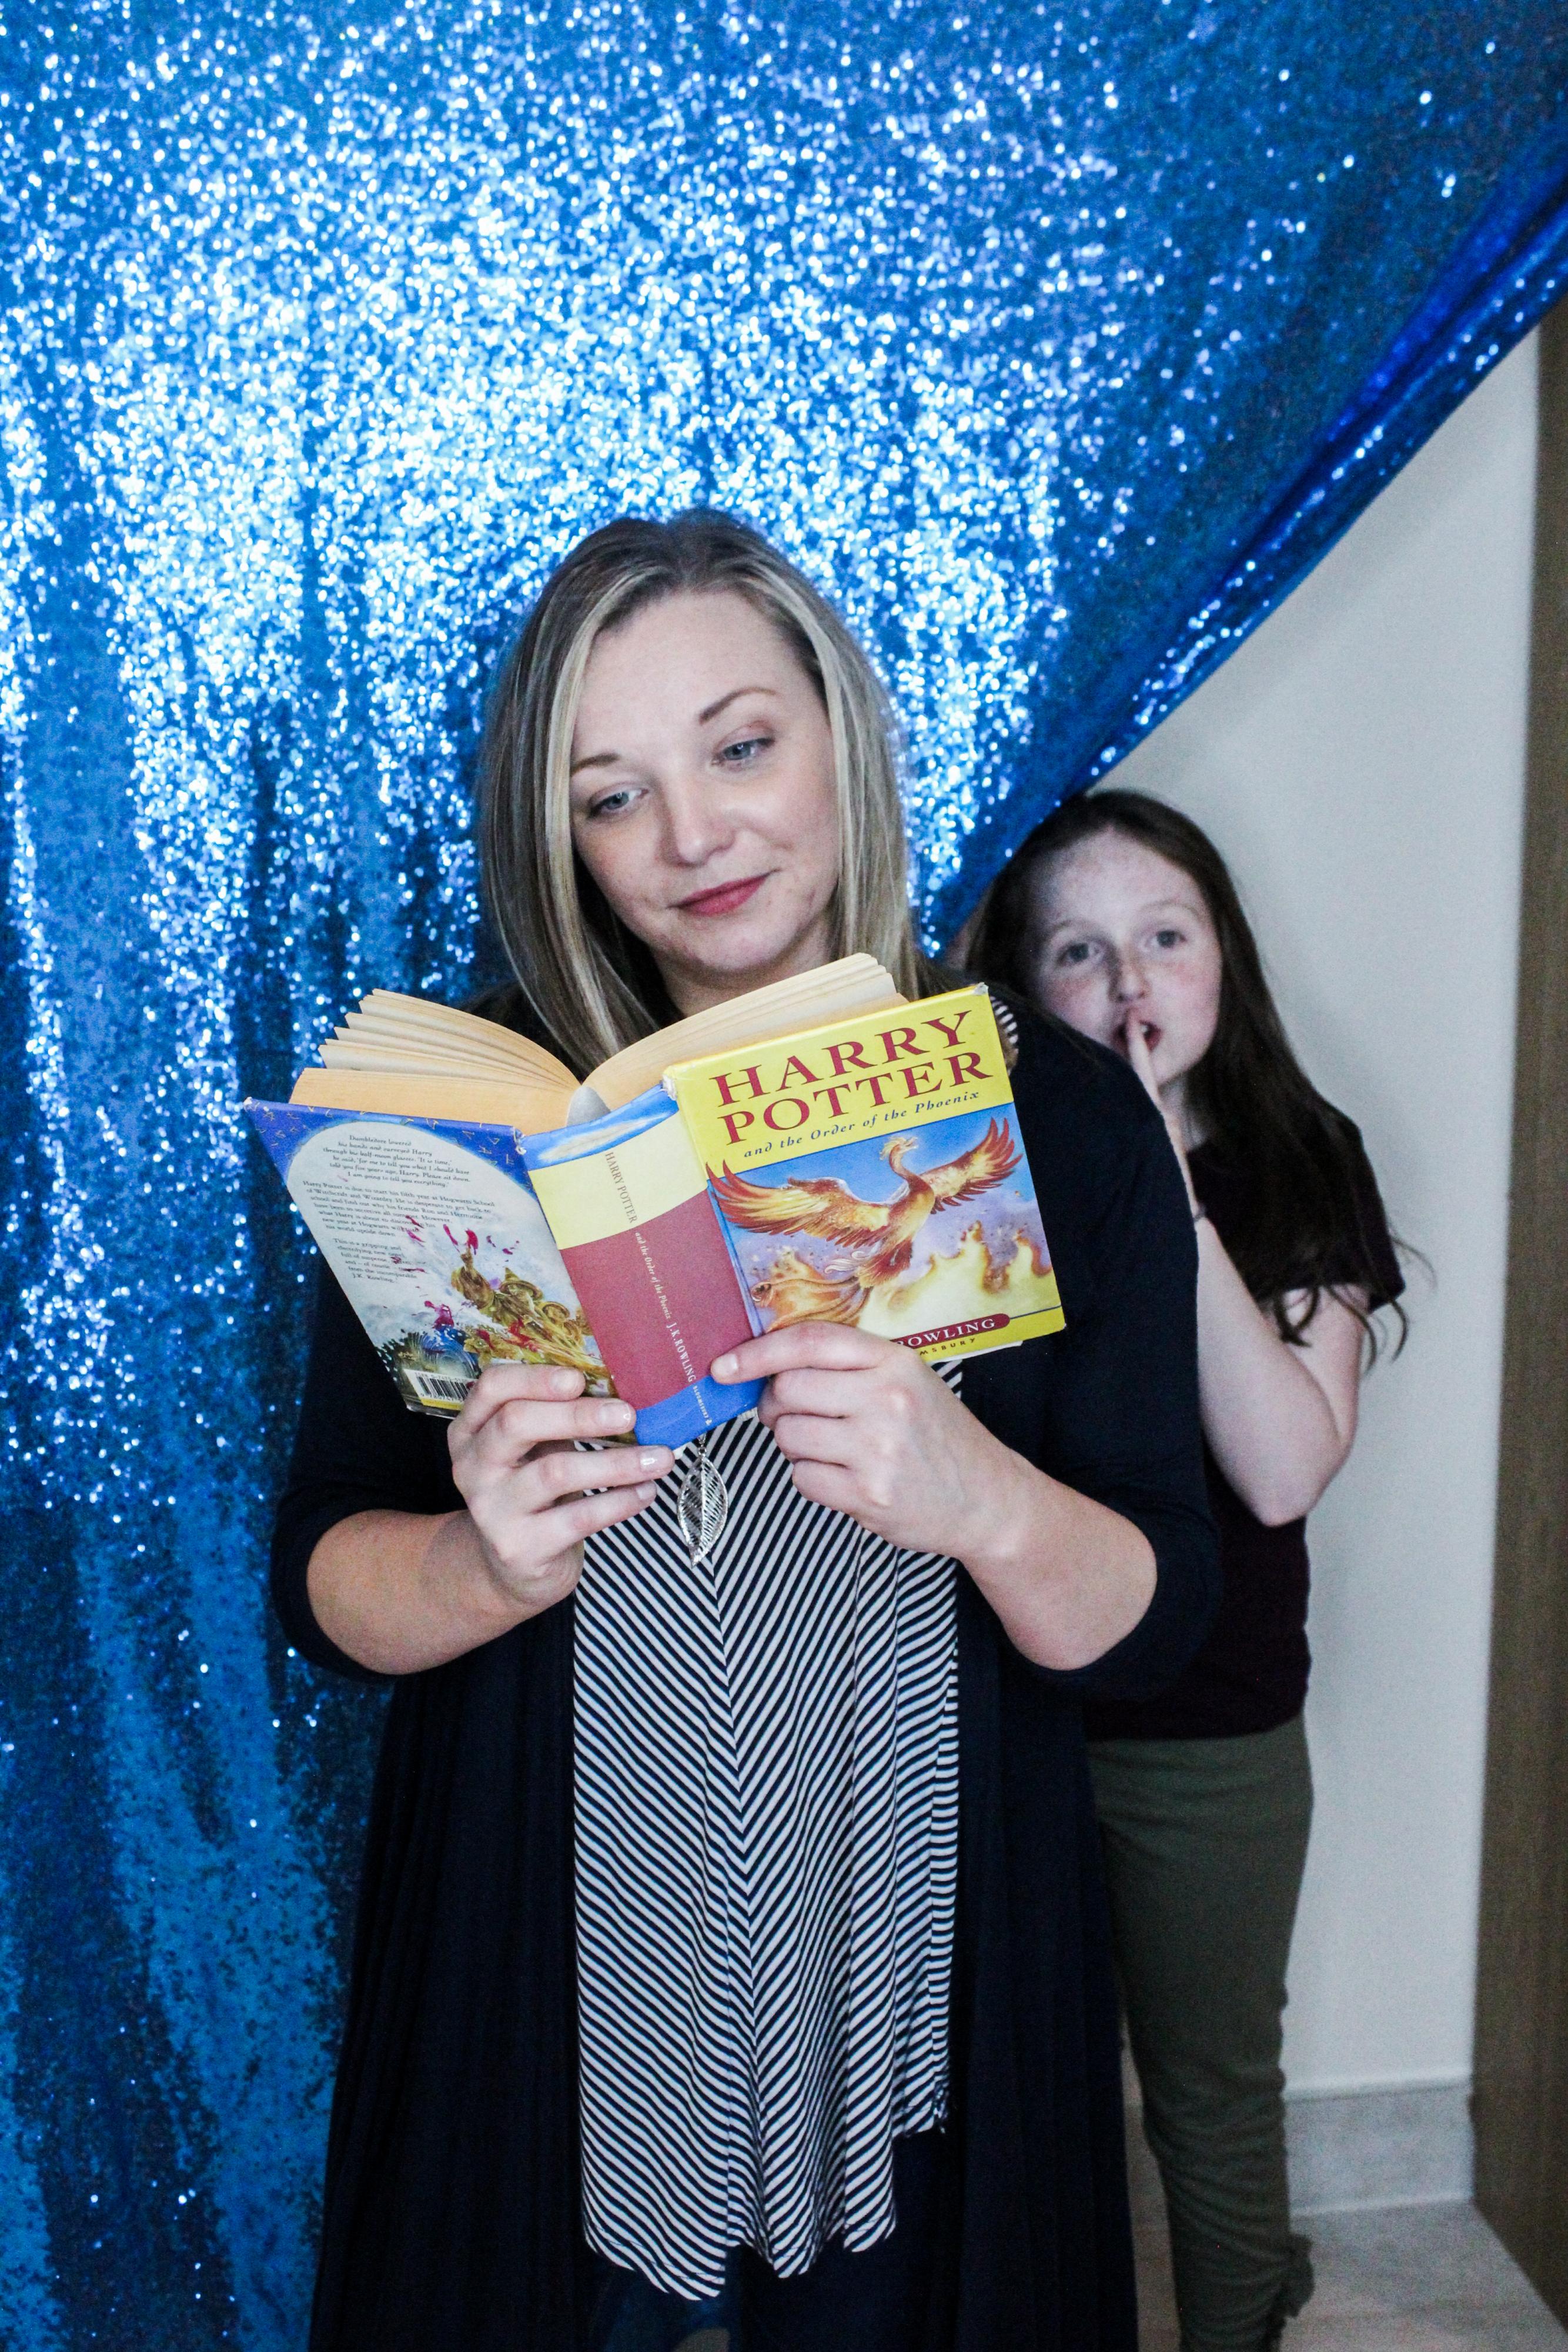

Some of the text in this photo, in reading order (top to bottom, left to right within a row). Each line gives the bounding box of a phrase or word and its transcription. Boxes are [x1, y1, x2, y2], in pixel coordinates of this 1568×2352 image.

[709, 1010, 972, 1107] HARRY
[721, 1051, 994, 1145] POTTER
[744, 1090, 980, 1157] and the Order of the Phoenix
[605, 1151, 624, 1184] HARRY
[617, 1185, 638, 1224] POTTER
[635, 1232, 646, 1244] and
[640, 1245, 648, 1256] the
[644, 1257, 655, 1275] Order
[654, 1284, 663, 1294] the
[658, 1295, 672, 1319] Phoenix
[920, 1338, 975, 1356] MSBURY
